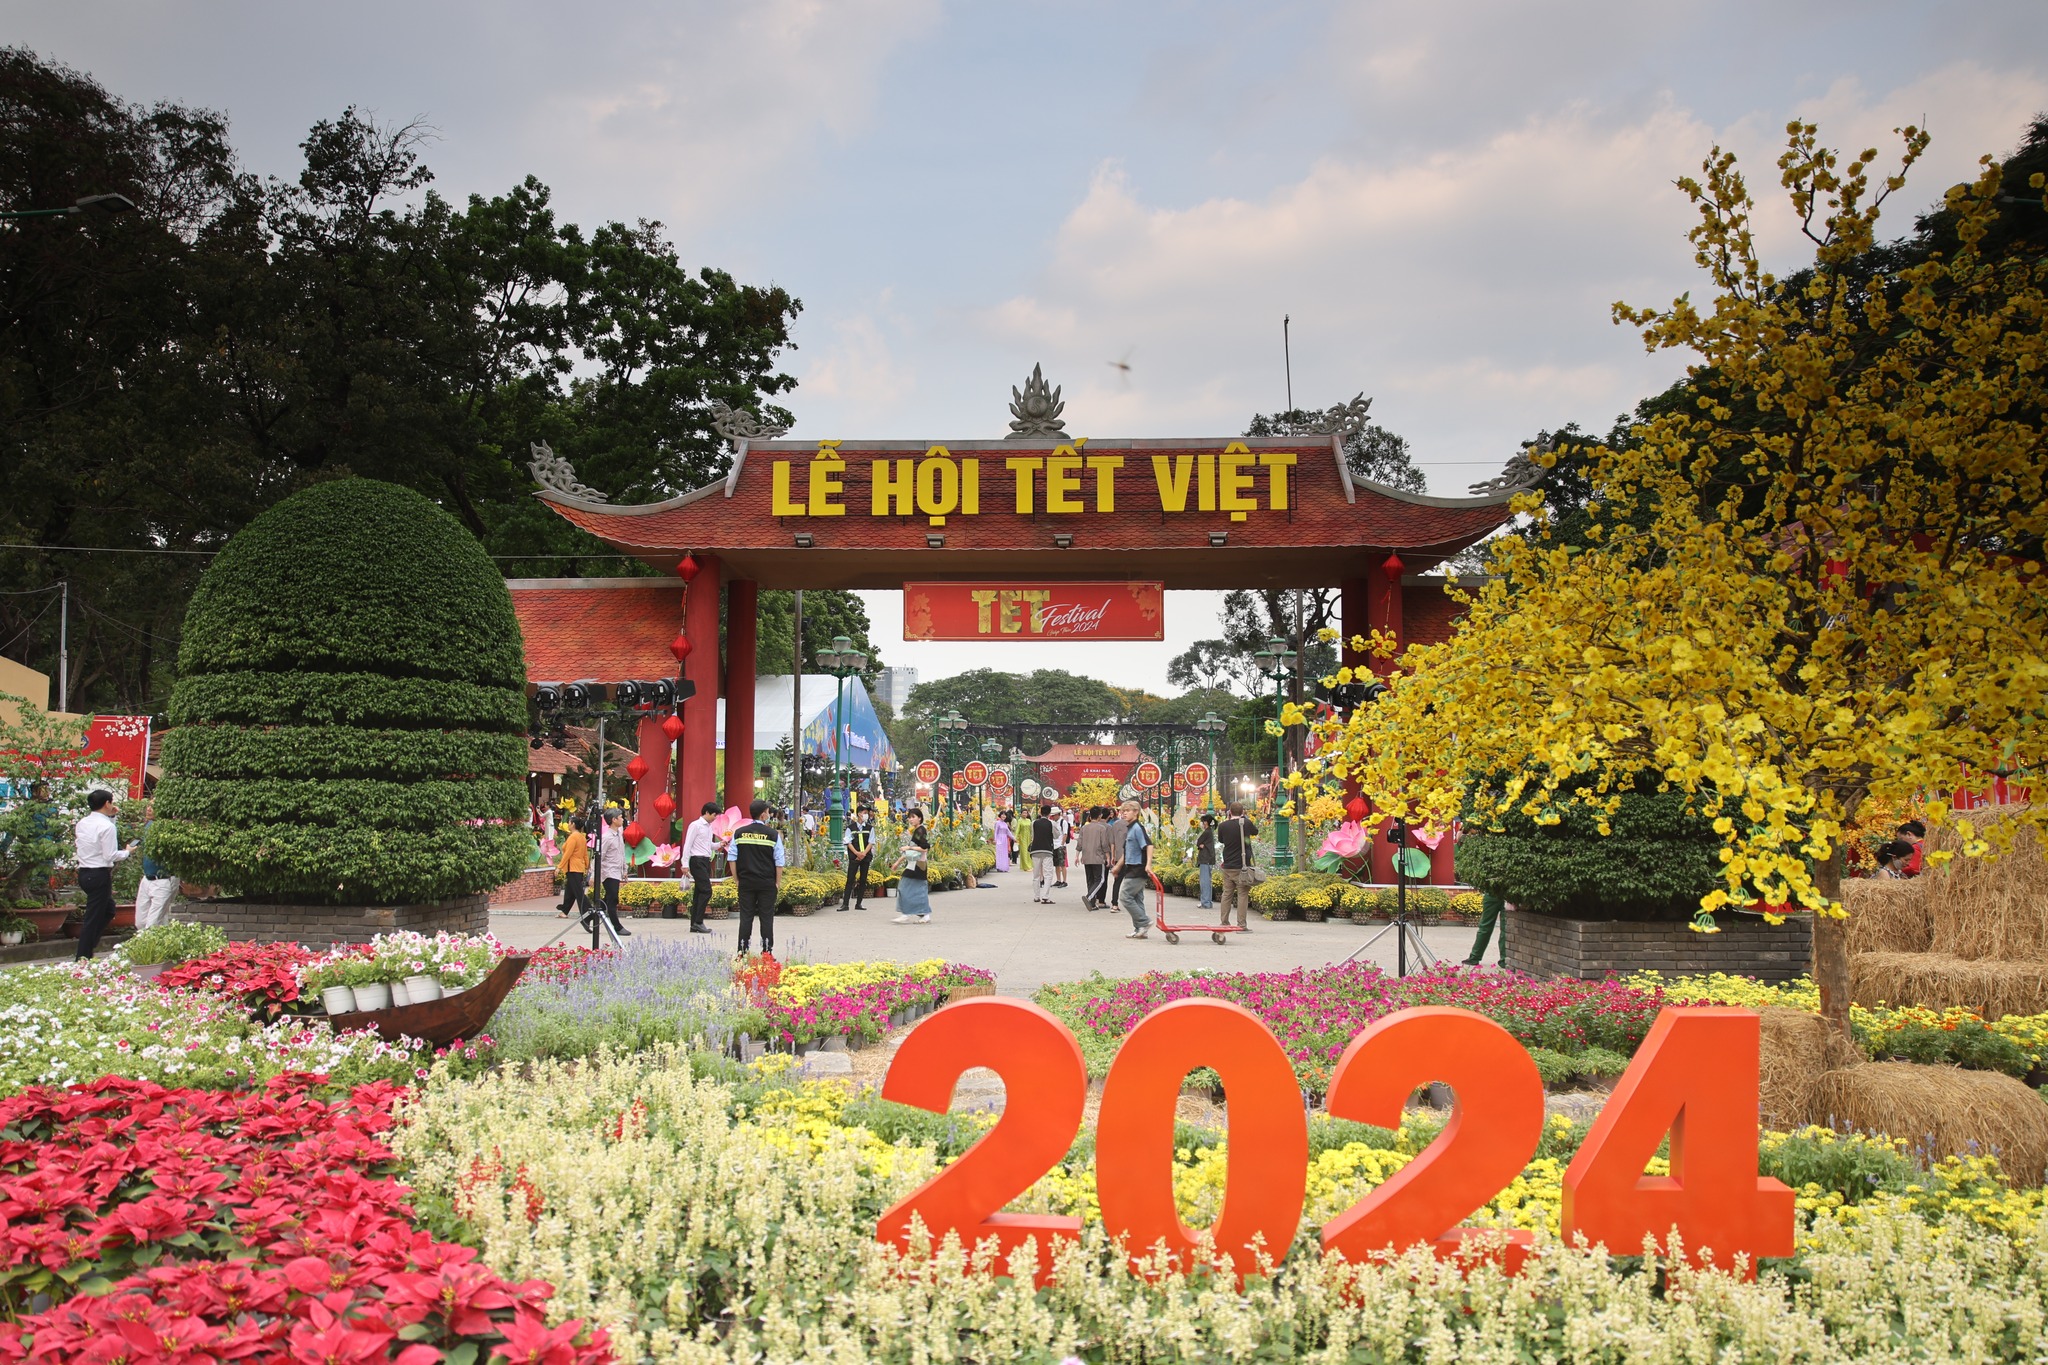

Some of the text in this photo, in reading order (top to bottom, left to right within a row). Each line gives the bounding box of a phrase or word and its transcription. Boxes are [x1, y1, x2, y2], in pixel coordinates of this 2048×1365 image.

[772, 437, 1298, 526] LỄ HỘI TẾT VIỆT
[1034, 598, 1112, 632] Festival
[1071, 620, 1100, 634] 2024
[741, 832, 768, 840] SECURITY
[877, 996, 1795, 1287] 2024
